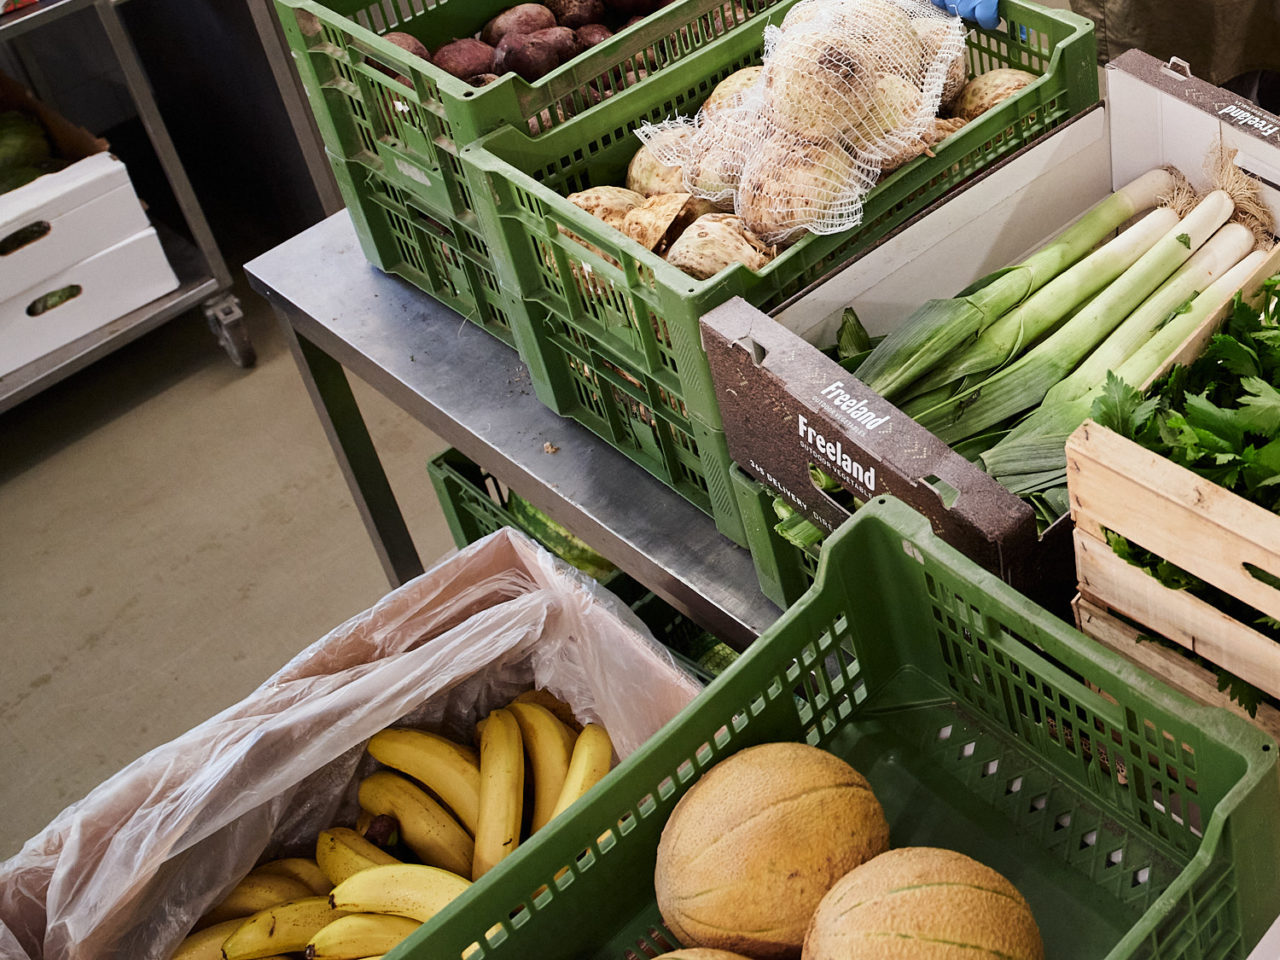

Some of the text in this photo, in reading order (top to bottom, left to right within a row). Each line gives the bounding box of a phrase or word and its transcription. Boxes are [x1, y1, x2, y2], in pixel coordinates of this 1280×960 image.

[1217, 104, 1280, 136] Freeland
[820, 380, 891, 430] Freeland
[798, 414, 876, 491] Freeland
[799, 440, 832, 470] OUTDOOR
[766, 472, 808, 511] DELIVERY
